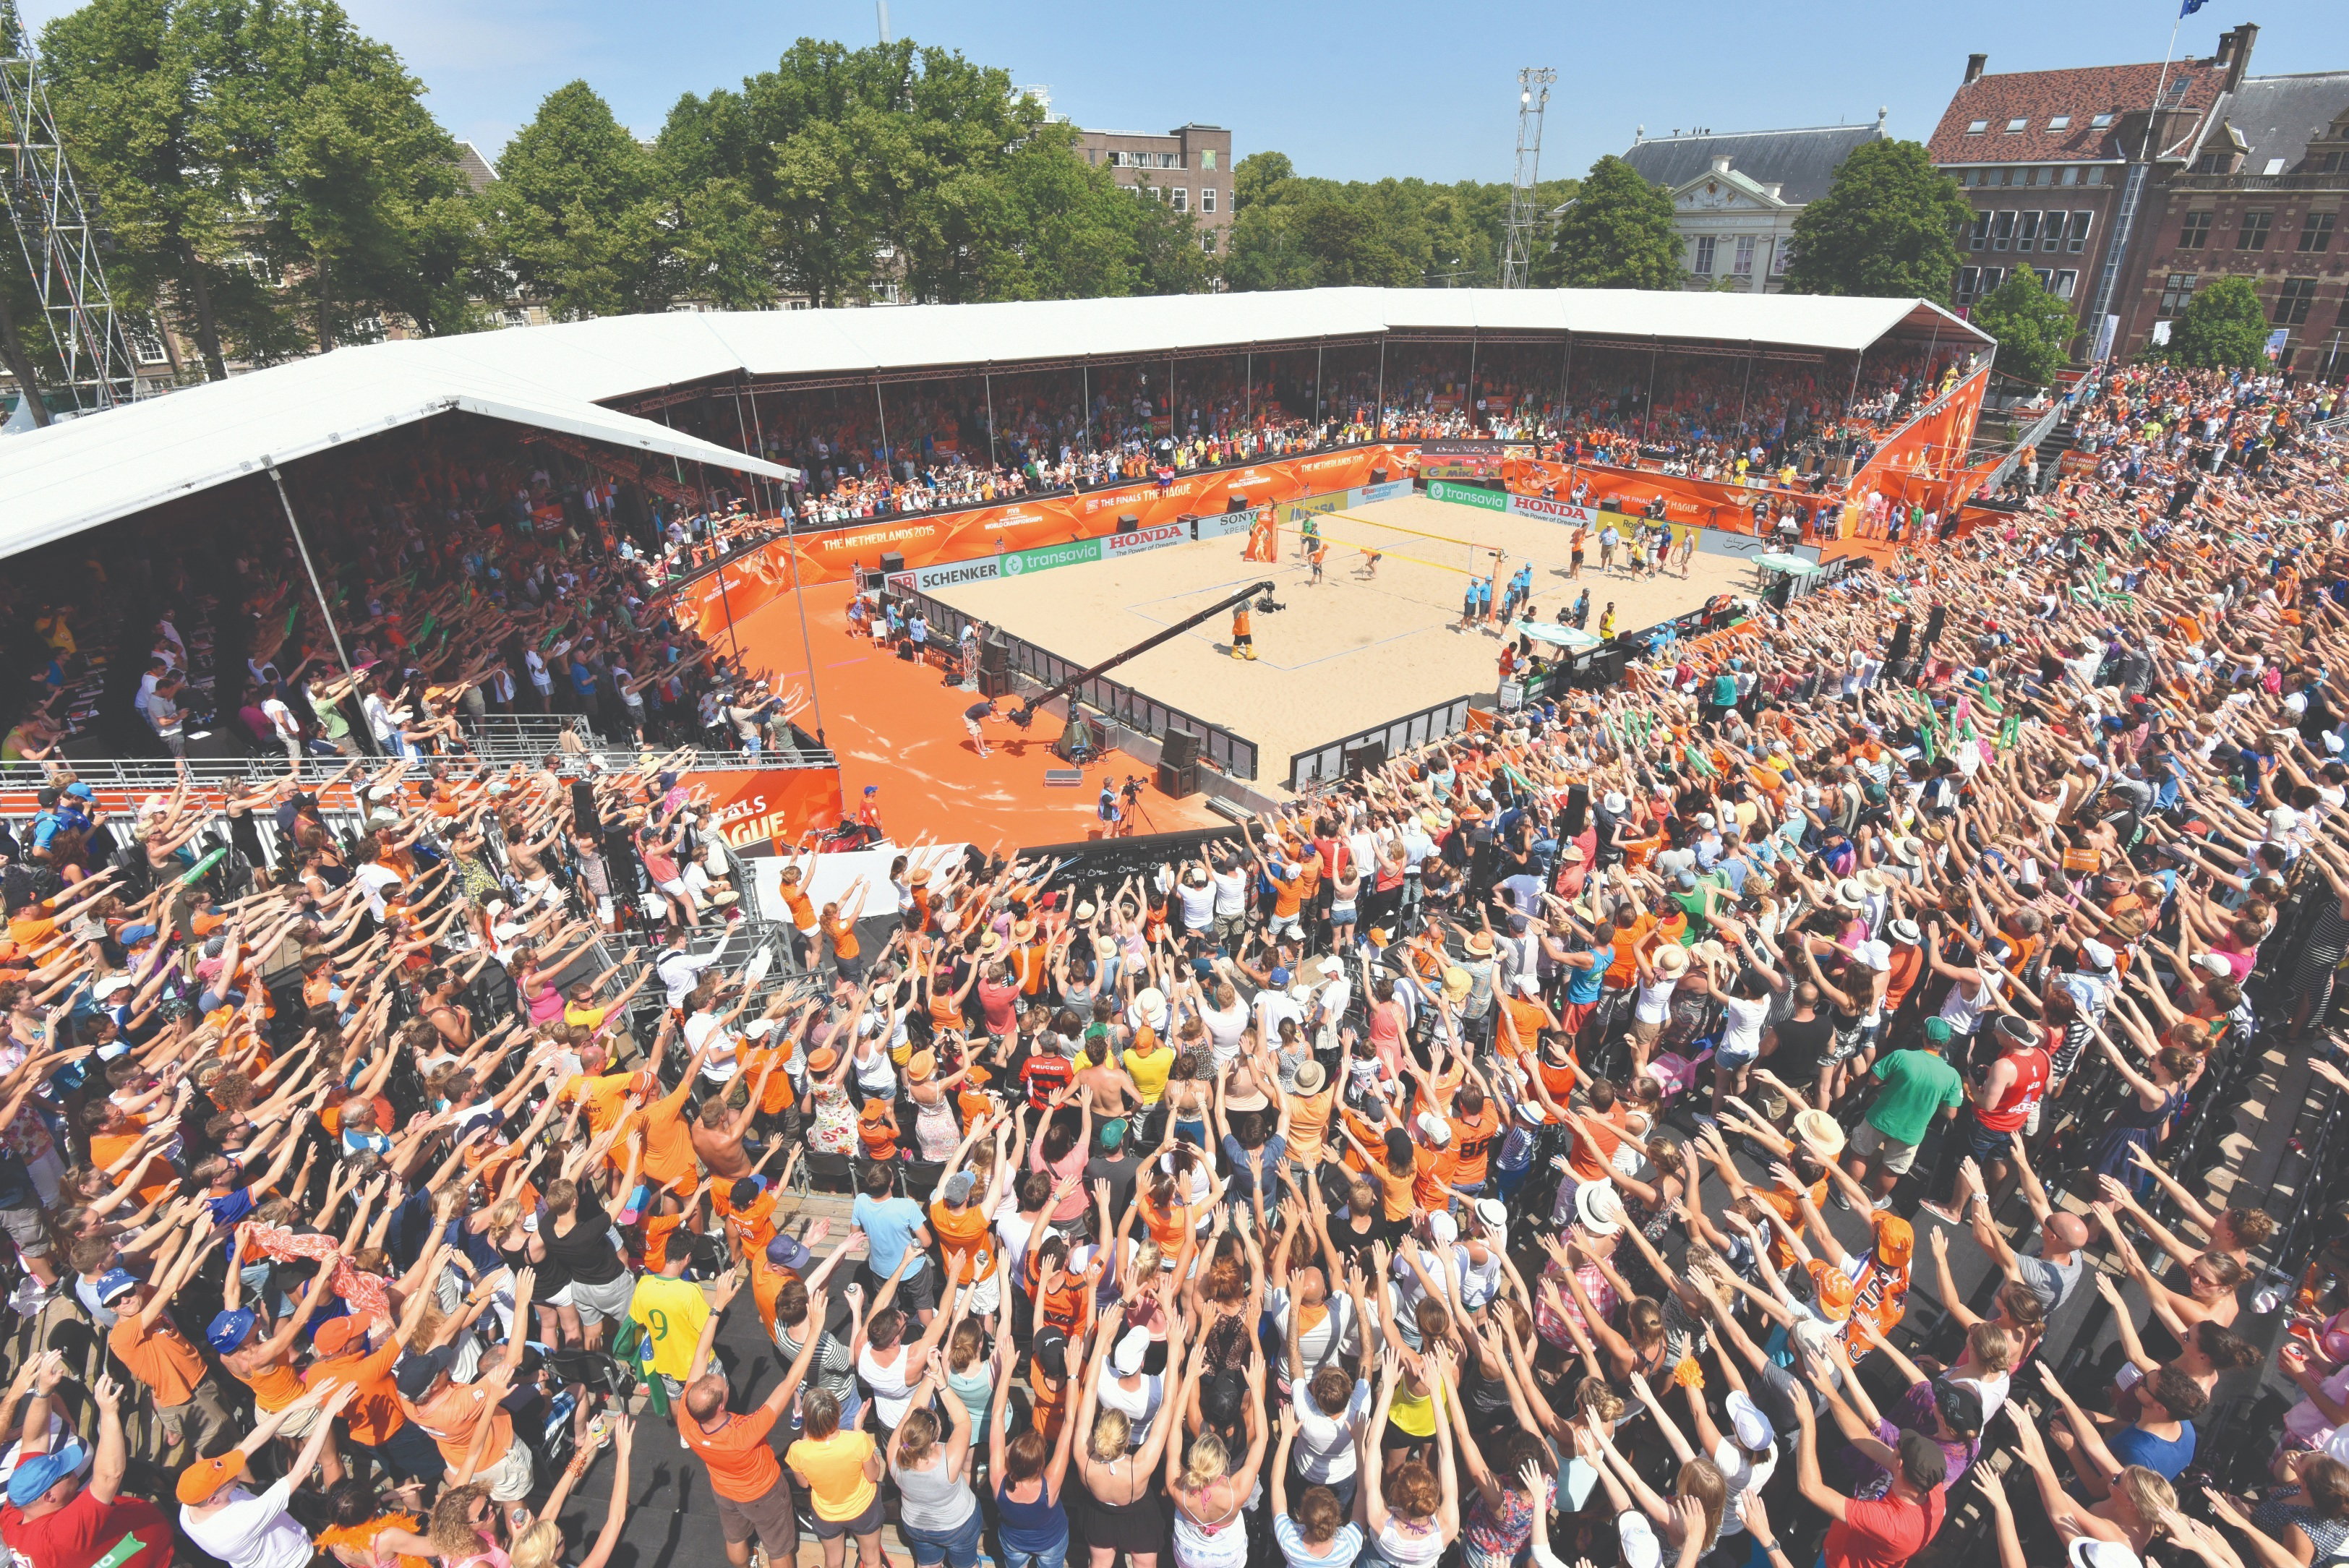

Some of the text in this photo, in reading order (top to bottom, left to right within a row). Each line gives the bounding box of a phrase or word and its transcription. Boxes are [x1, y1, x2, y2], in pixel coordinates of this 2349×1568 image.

[1301, 454, 1364, 474] THE NETHERLANDS 2015
[1101, 497, 1115, 507] THE
[1116, 494, 1142, 505] FINALS
[1143, 489, 1160, 502] THE
[1162, 483, 1191, 498] HAGUE
[1446, 487, 1503, 507] transavia
[1514, 497, 1588, 520] HONDA
[1671, 501, 1699, 513] HAGUE
[1004, 516, 1043, 527] CHAMPIONSHIPS
[1220, 511, 1256, 526] SONY
[1530, 513, 1548, 522] Power
[1557, 518, 1580, 528] Dreams
[823, 526, 935, 551] THE NETHERLANDS 2015
[1109, 526, 1183, 549] HONDA
[1027, 545, 1097, 568] transavia
[1128, 547, 1147, 555] Power
[923, 564, 998, 588] SCHENKER
[2032, 1065, 2038, 1077] 1
[648, 1308, 668, 1342] 9
